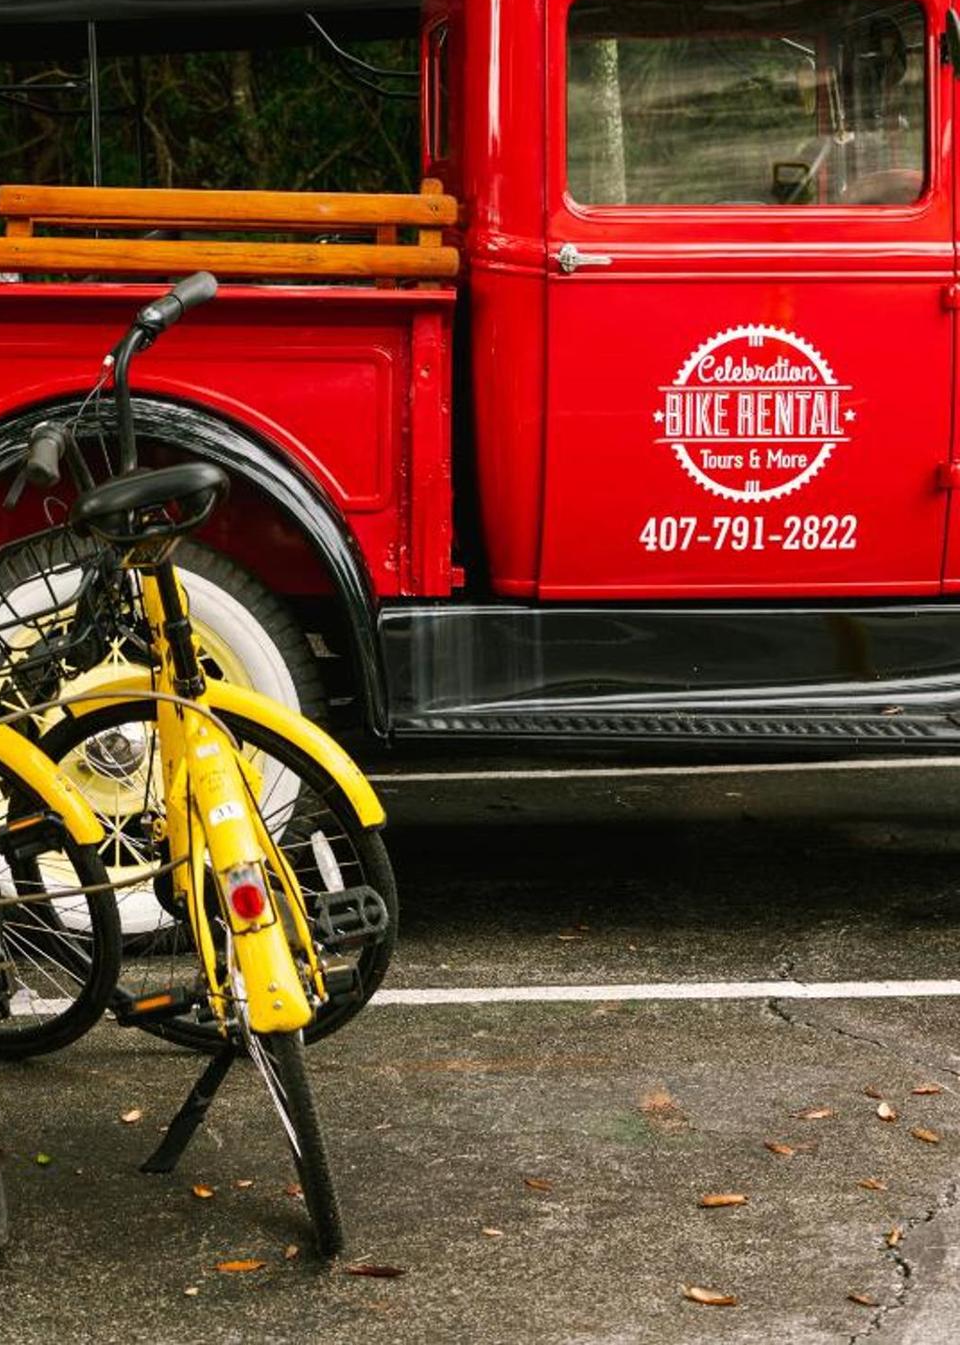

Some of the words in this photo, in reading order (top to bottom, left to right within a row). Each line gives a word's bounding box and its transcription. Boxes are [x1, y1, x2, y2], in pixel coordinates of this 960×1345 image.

[698, 355, 817, 383] Celebration
[665, 391, 729, 437] BIKE
[737, 390, 844, 436] RENTAL
[700, 449, 743, 469] Tours
[749, 449, 760, 468] &
[767, 449, 807, 468] More
[639, 514, 858, 551] 407-791-2822
